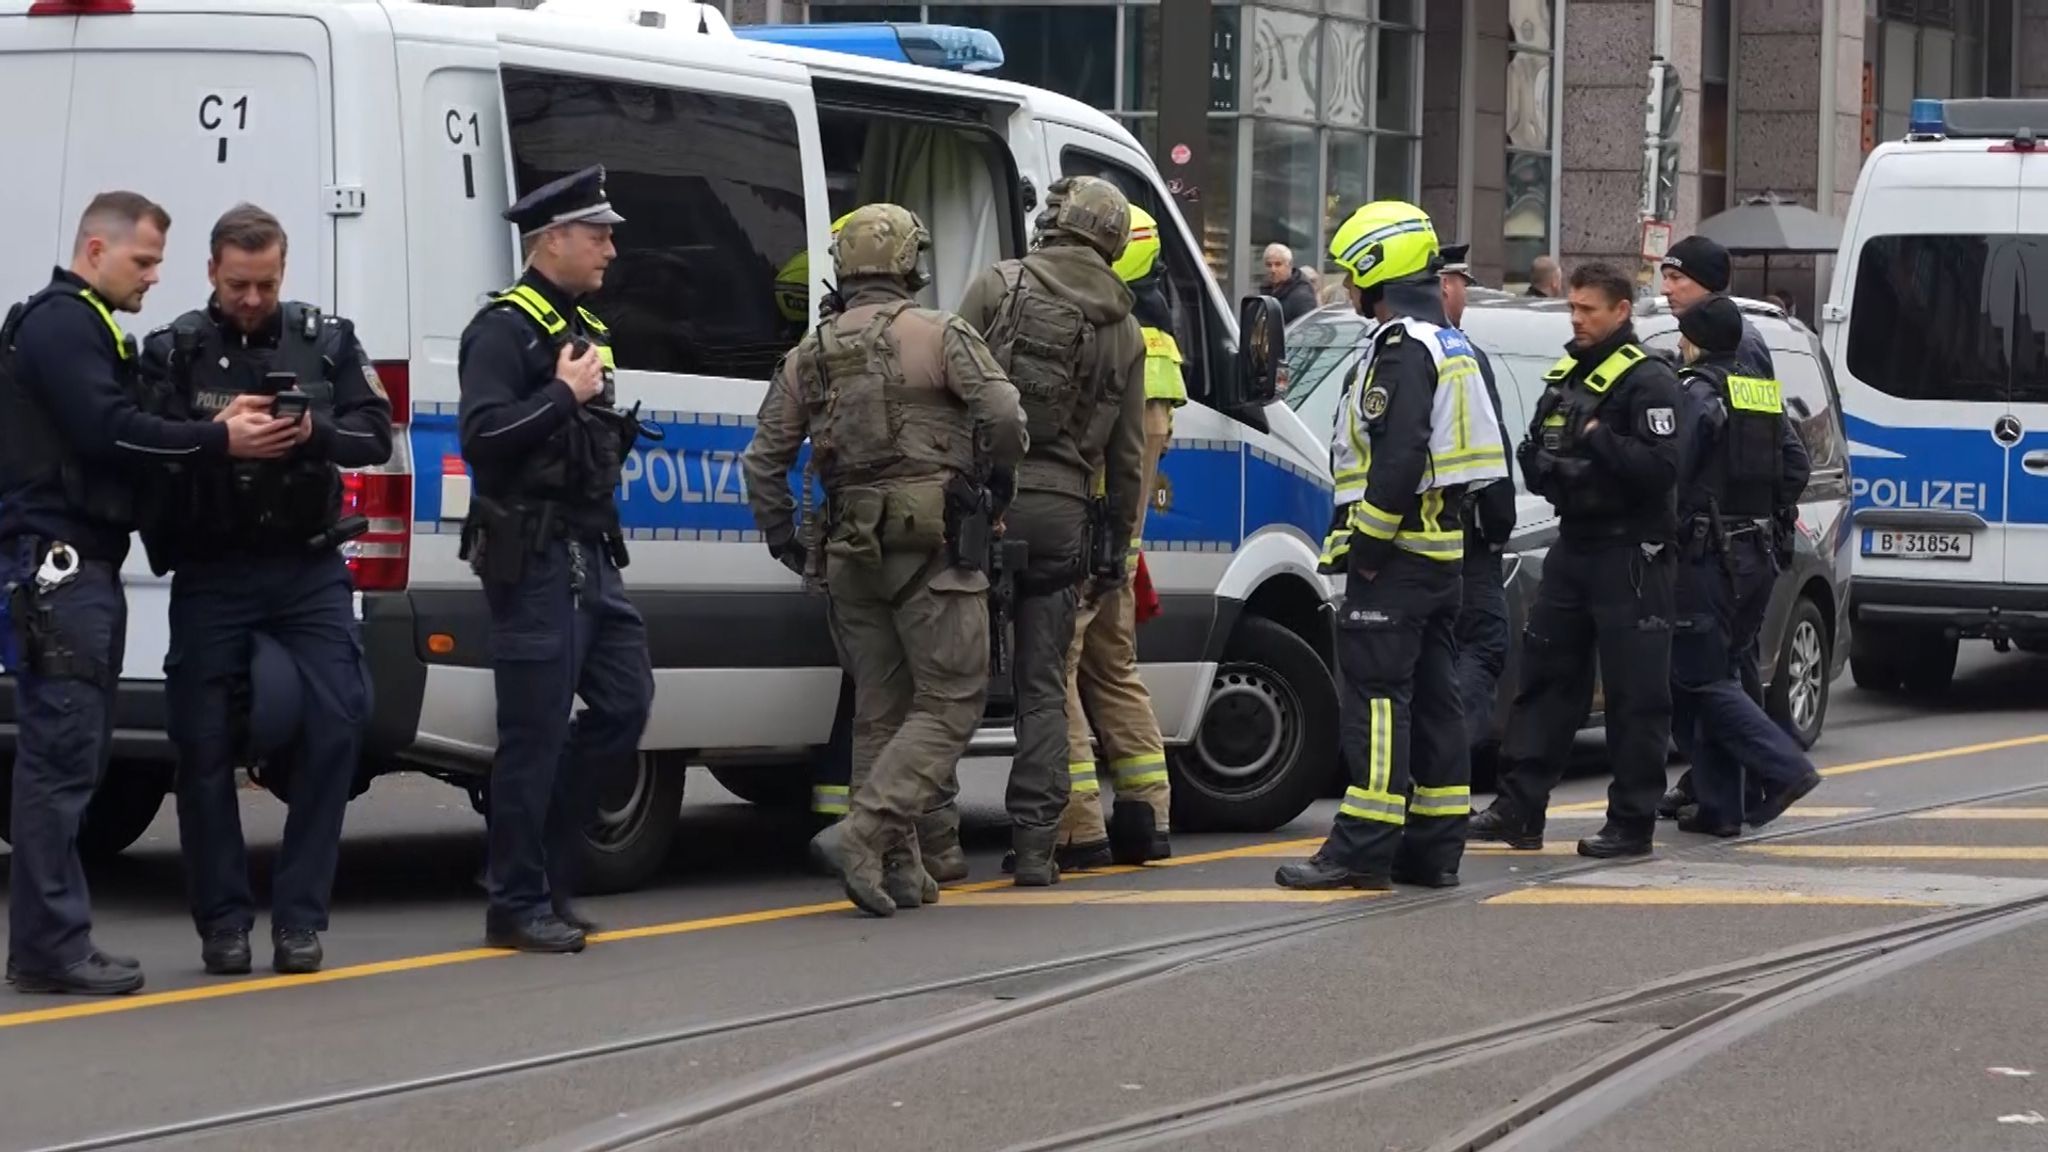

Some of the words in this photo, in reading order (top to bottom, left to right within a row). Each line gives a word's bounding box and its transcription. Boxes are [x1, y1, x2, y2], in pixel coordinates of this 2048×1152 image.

[196, 391, 236, 410] POLIZ
[1852, 478, 1986, 511] POLIZEI
[1881, 533, 1893, 551] B
[1905, 534, 1961, 554] 31854
